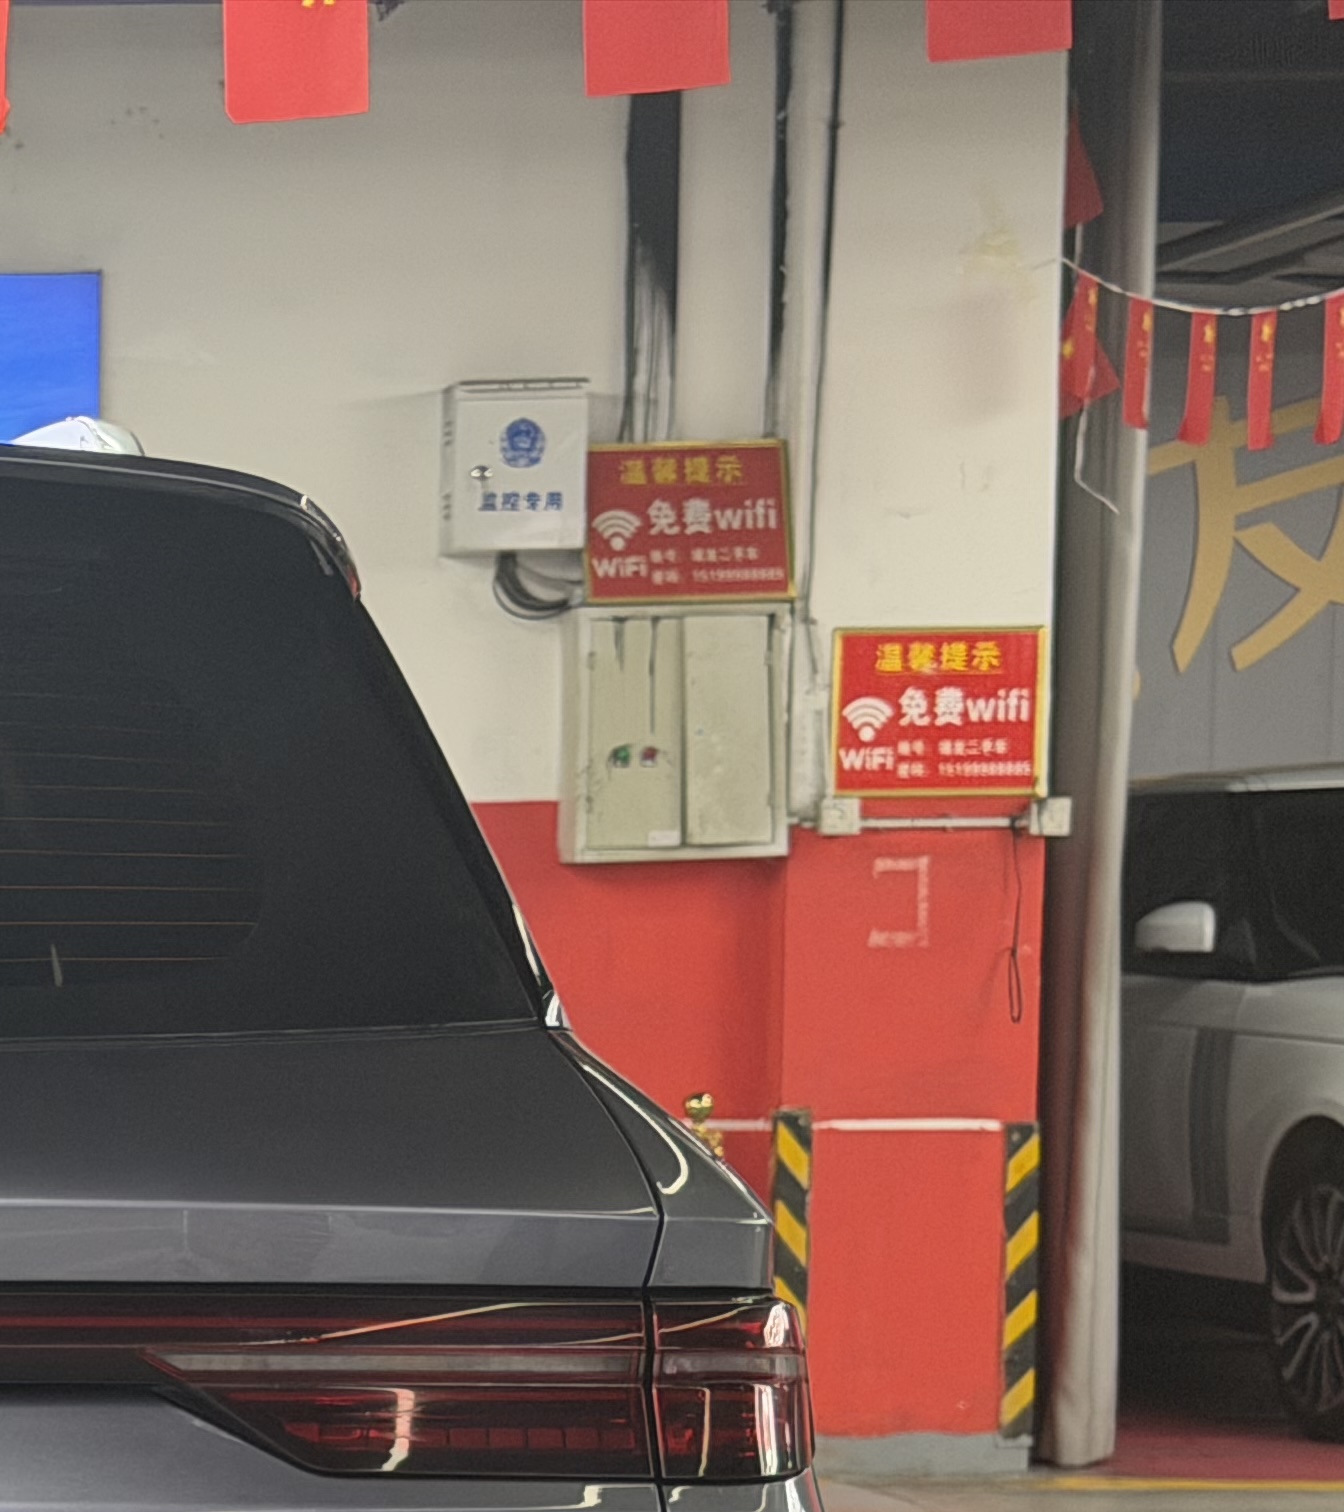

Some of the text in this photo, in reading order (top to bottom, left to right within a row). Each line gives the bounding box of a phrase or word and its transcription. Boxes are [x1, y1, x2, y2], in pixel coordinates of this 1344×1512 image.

[620, 455, 744, 485] 温馨提示
[477, 491, 564, 513] 监控专用
[592, 555, 648, 579] WiFi
[875, 641, 1003, 672] 温馨提示
[838, 746, 896, 771] WiFi
